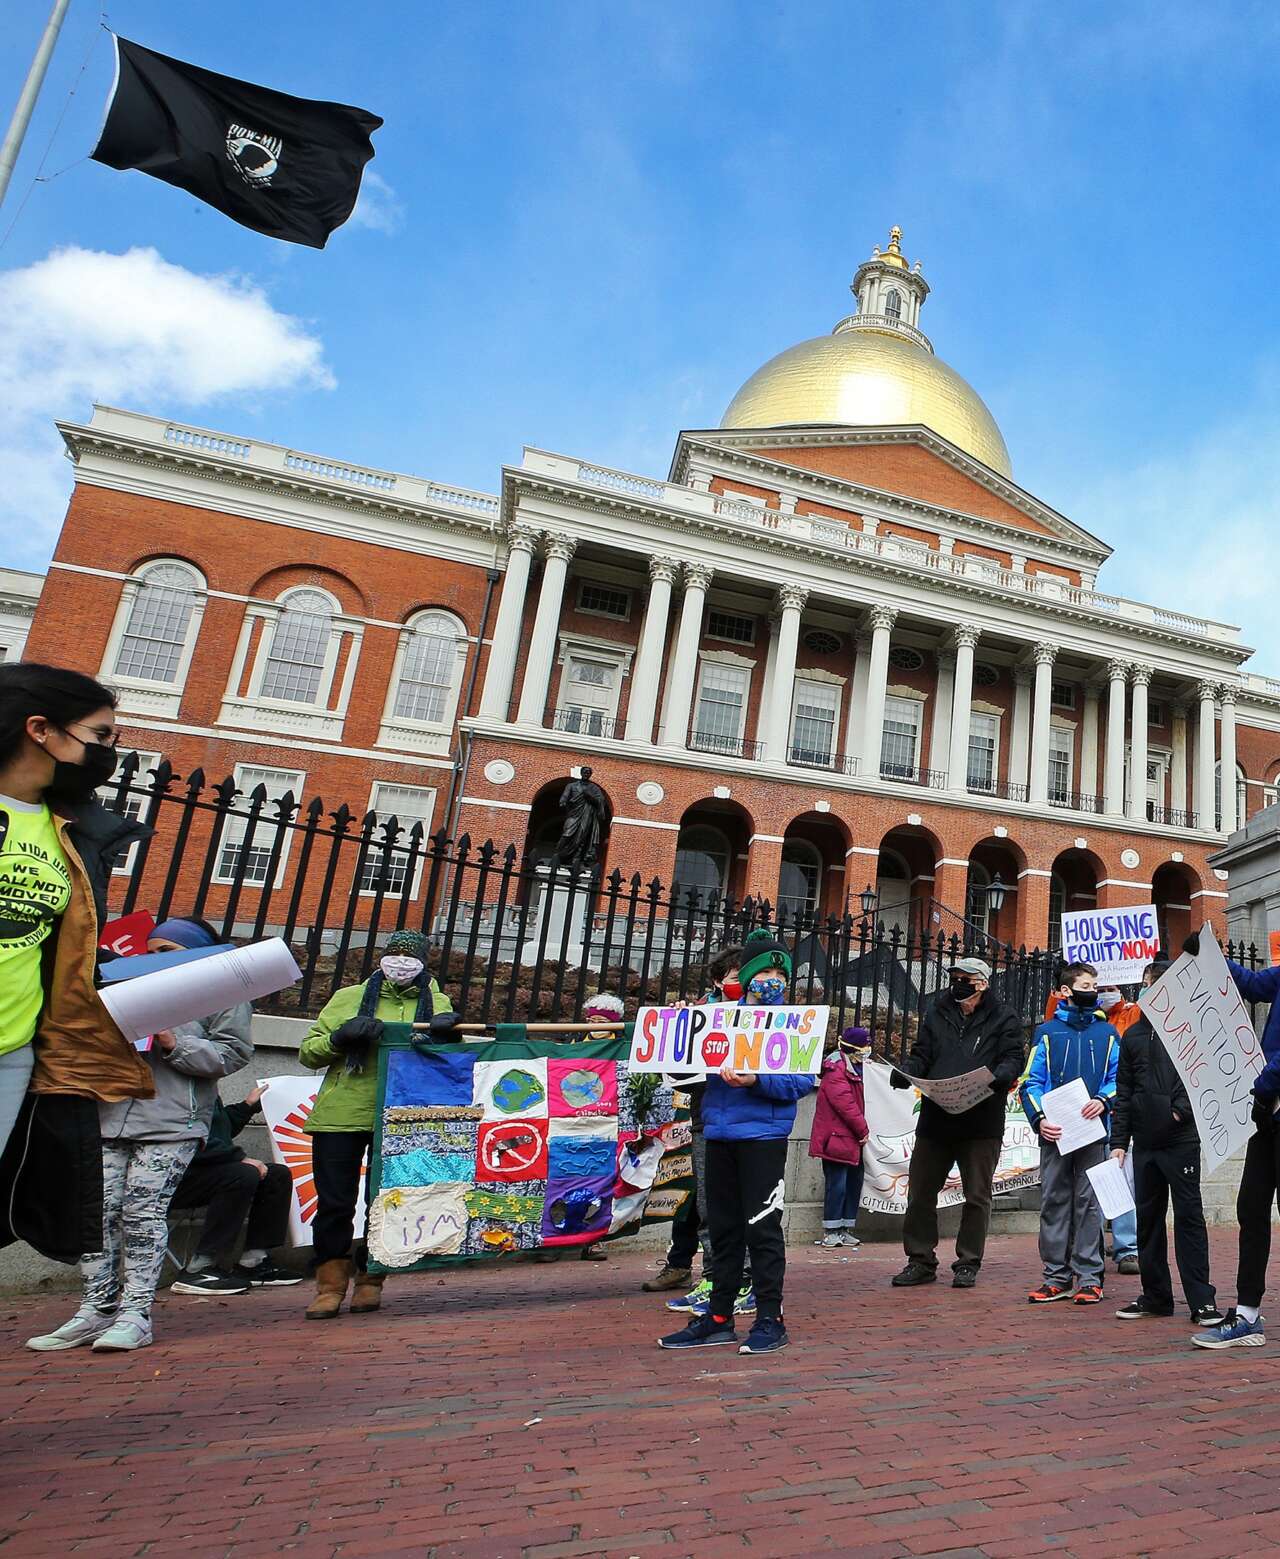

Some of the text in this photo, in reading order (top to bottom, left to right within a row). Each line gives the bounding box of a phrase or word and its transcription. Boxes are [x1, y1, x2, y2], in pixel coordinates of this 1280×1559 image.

[17, 841, 48, 861] VIDA
[13, 863, 39, 876] WE
[32, 880, 66, 894] NOT
[1065, 912, 1154, 943] HOUSING
[1067, 939, 1160, 965] EQUITY NOW
[636, 1007, 816, 1065] STOP EVICTIONS
[1218, 975, 1267, 1077] STOP
[704, 1031, 820, 1072] STOP NOW
[1176, 958, 1254, 1126] EVICTIONS
[1149, 985, 1229, 1157] DURING COVID
[944, 1192, 967, 1205] LINE
